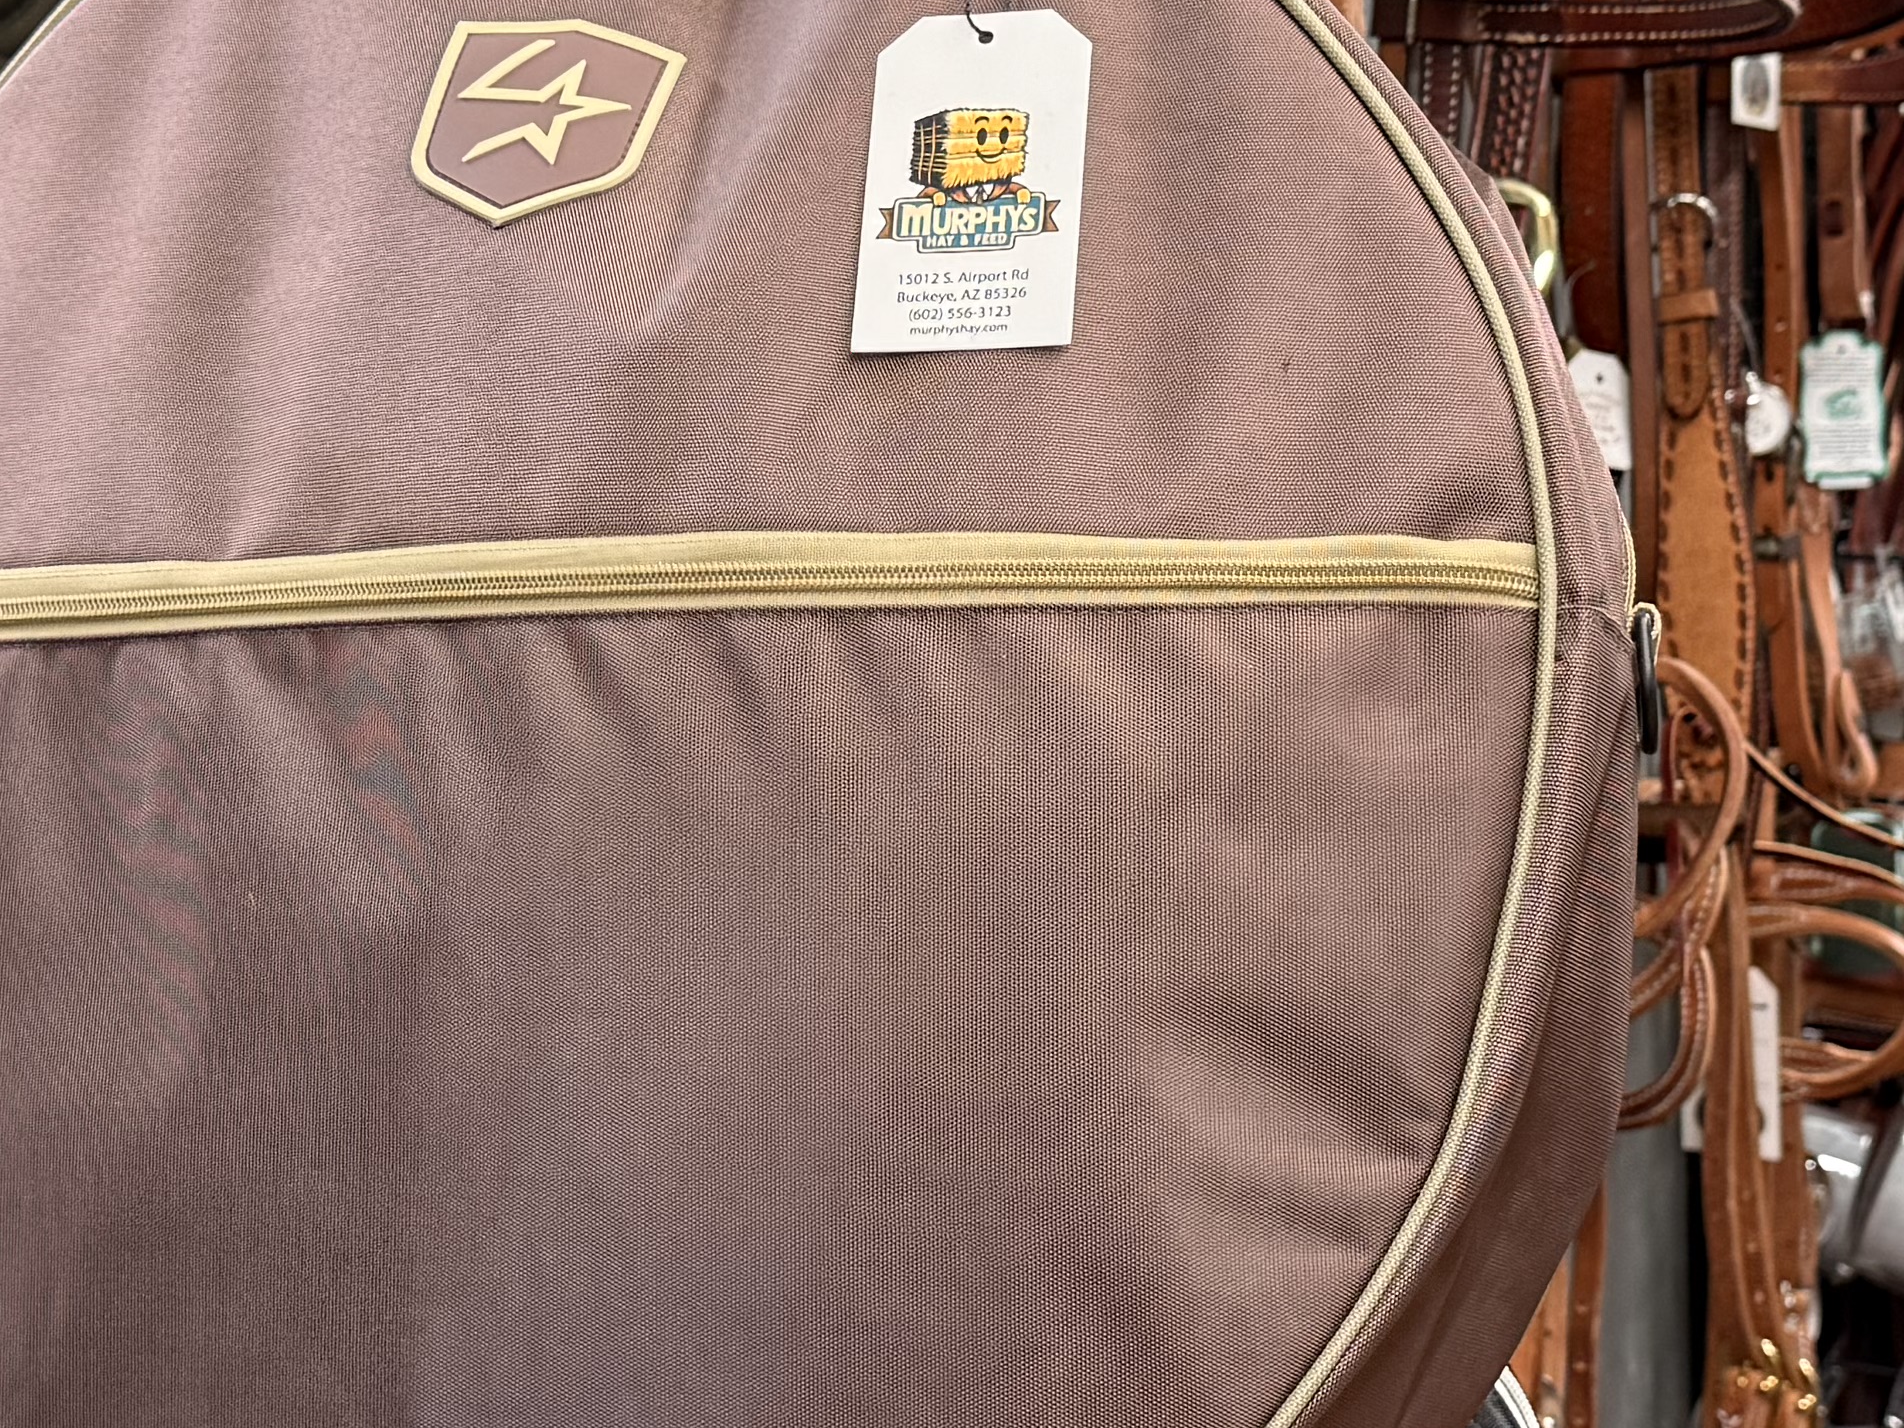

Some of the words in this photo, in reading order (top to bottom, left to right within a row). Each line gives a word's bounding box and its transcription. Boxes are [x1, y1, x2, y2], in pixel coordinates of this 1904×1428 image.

[926, 235, 955, 248] HAY
[974, 232, 1008, 246] FEED
[898, 273, 940, 286] 15012
[943, 271, 954, 284] S.
[957, 270, 1008, 286] Airport
[1011, 268, 1030, 281] Rd
[897, 290, 957, 305] Buckeye,
[961, 289, 981, 301] AZ
[984, 286, 1028, 300] 85326
[908, 307, 944, 322] (602)
[947, 304, 1013, 320] 556-3123
[909, 322, 1009, 337] murphyshay.com
